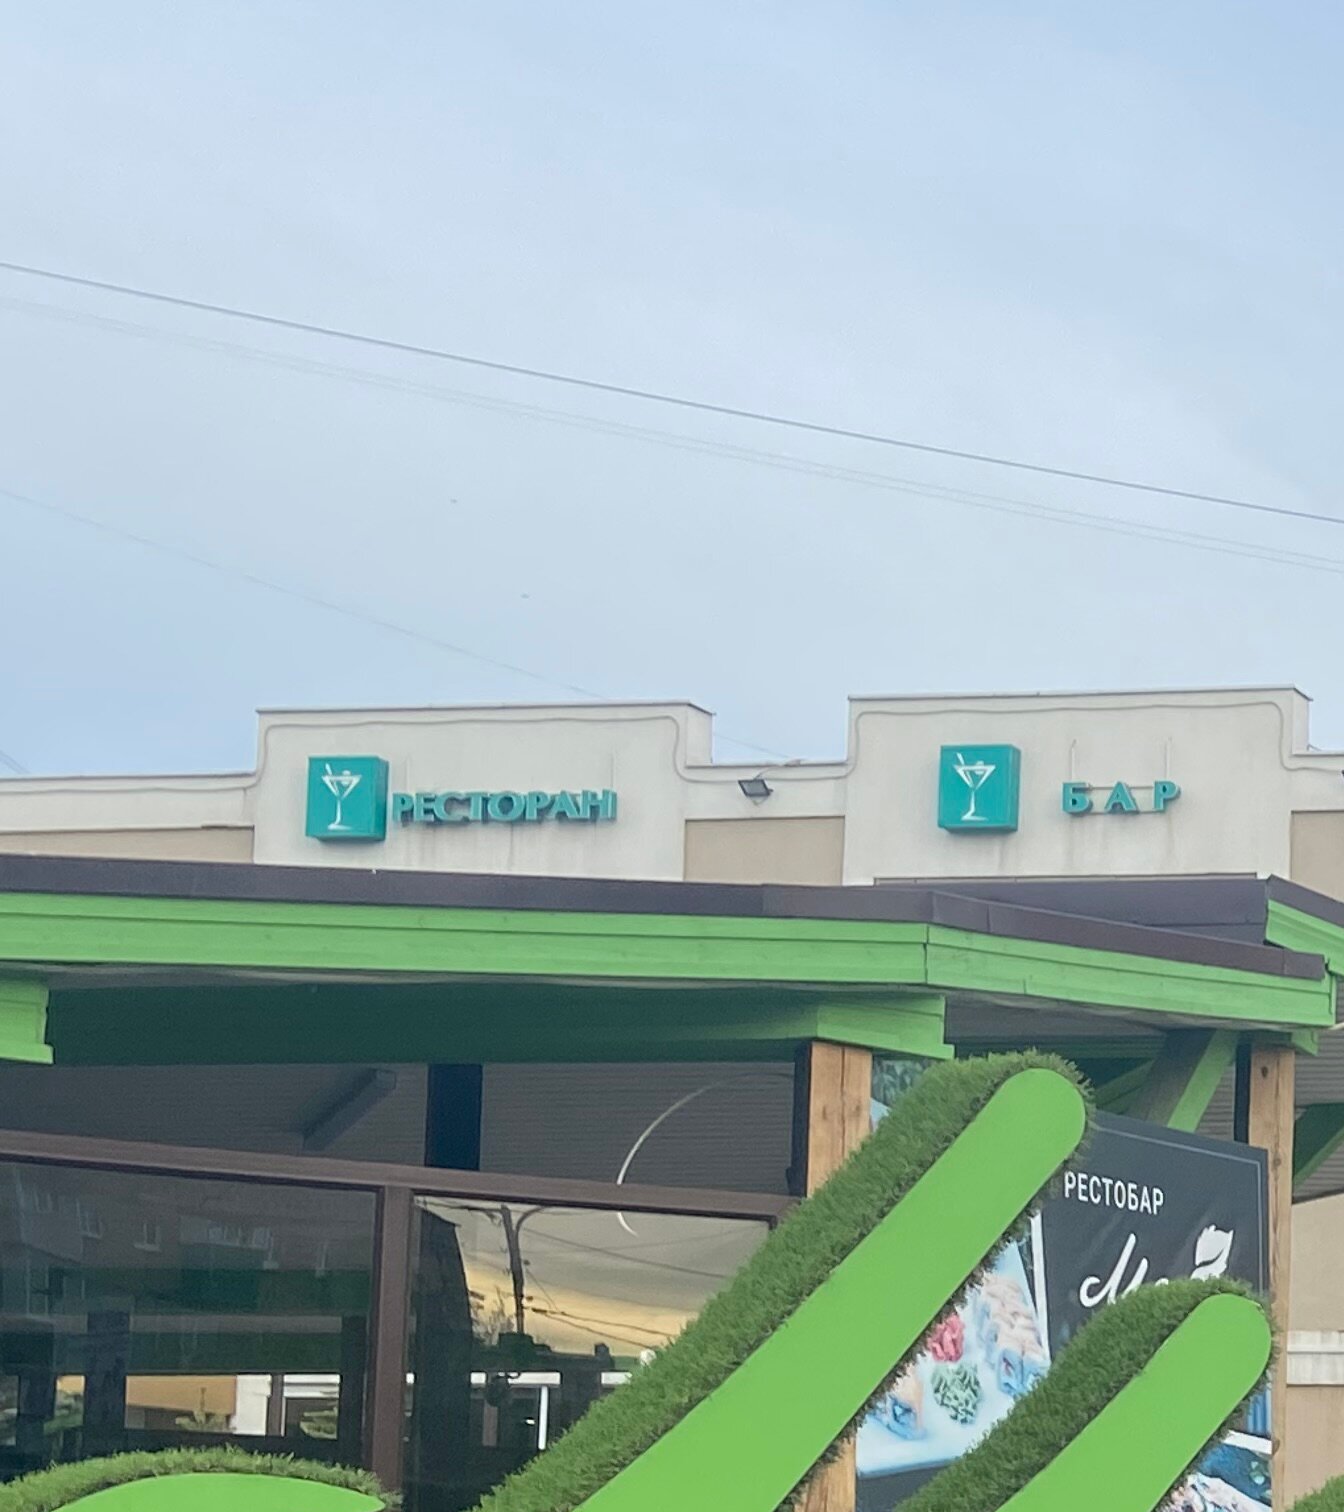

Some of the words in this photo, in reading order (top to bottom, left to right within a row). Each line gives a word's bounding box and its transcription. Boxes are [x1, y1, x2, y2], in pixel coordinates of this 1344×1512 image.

[391, 788, 618, 824] РЕСТОРАН
[1061, 779, 1182, 816] БАР
[1063, 1171, 1165, 1216] РЕСТОБАР
